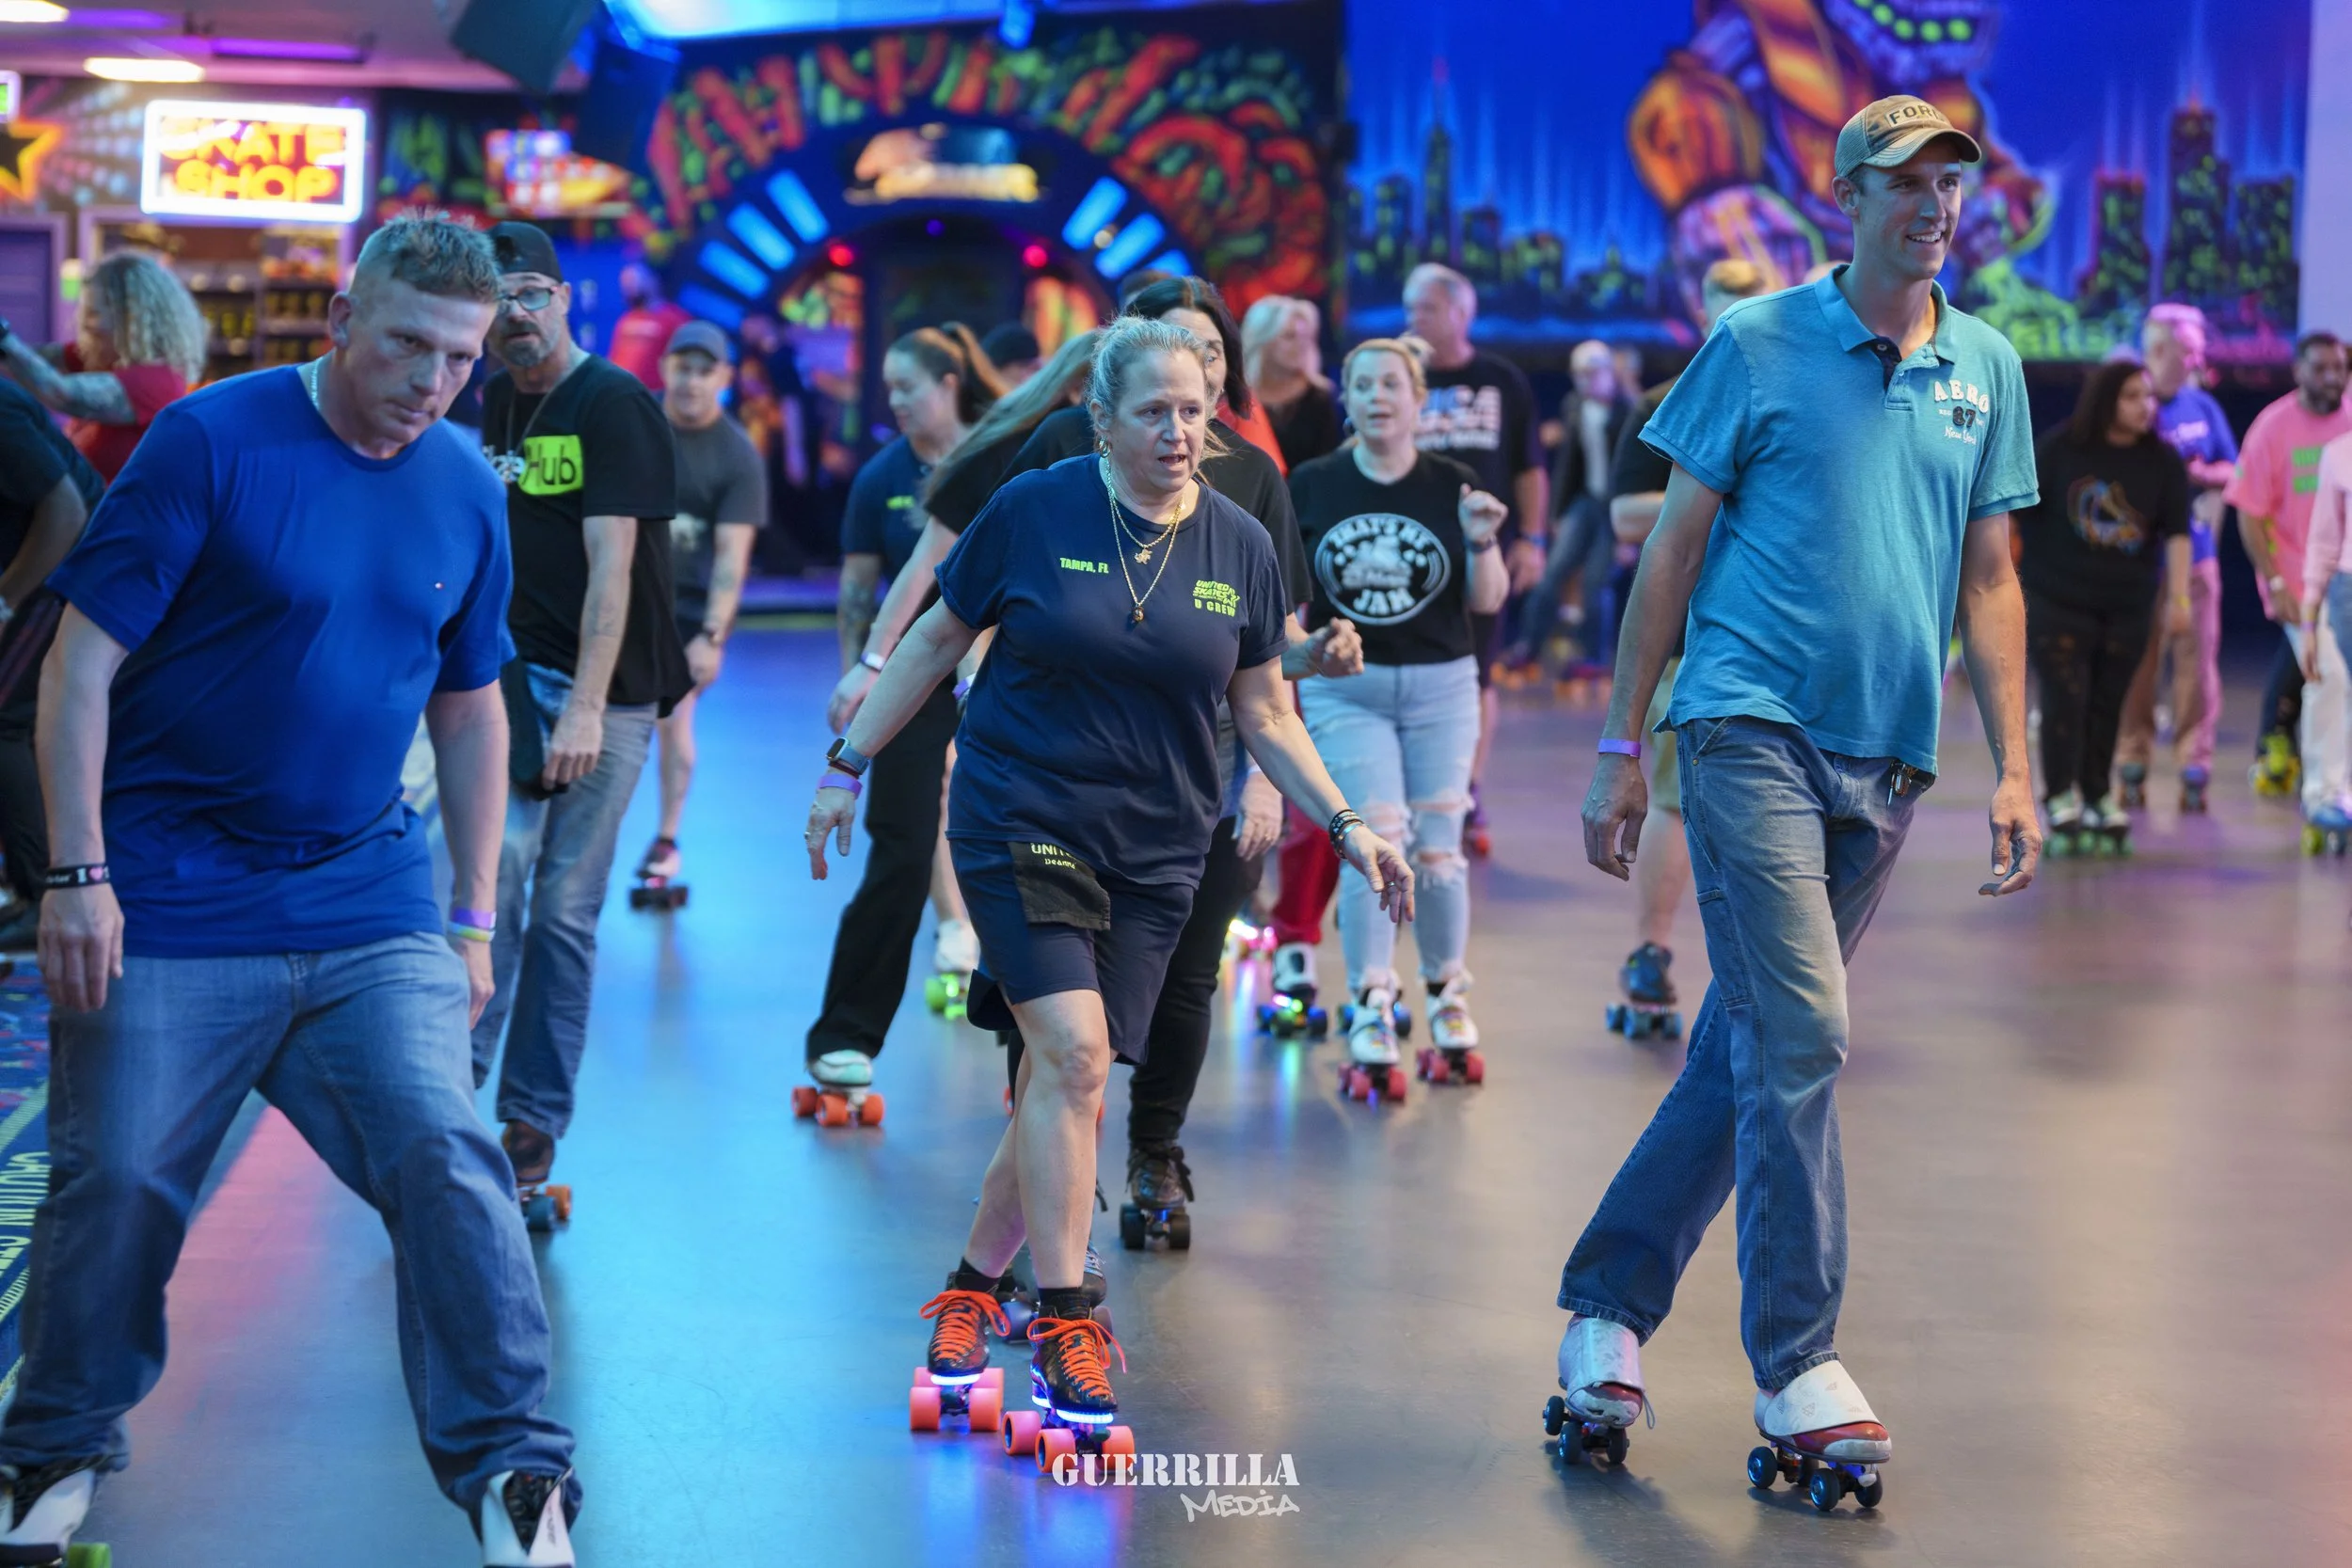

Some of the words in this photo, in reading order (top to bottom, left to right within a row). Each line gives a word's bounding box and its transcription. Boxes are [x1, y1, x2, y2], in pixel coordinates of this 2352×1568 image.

[159, 117, 344, 166] SKATE
[174, 159, 340, 202] SHOP
[1934, 380, 1989, 413] AERO
[1953, 406, 1976, 427] 87
[1943, 425, 1962, 439] New
[521, 442, 577, 487] Hub
[1327, 517, 1398, 548] THAT'S
[1059, 557, 1097, 574] TAMPA,
[1097, 562, 1110, 575] FL
[1194, 587, 1229, 598] SKATES
[1196, 579, 1230, 591] UNITED
[1195, 598, 1201, 609] U
[1206, 601, 1235, 617] CREW
[1352, 587, 1417, 616] JAM
